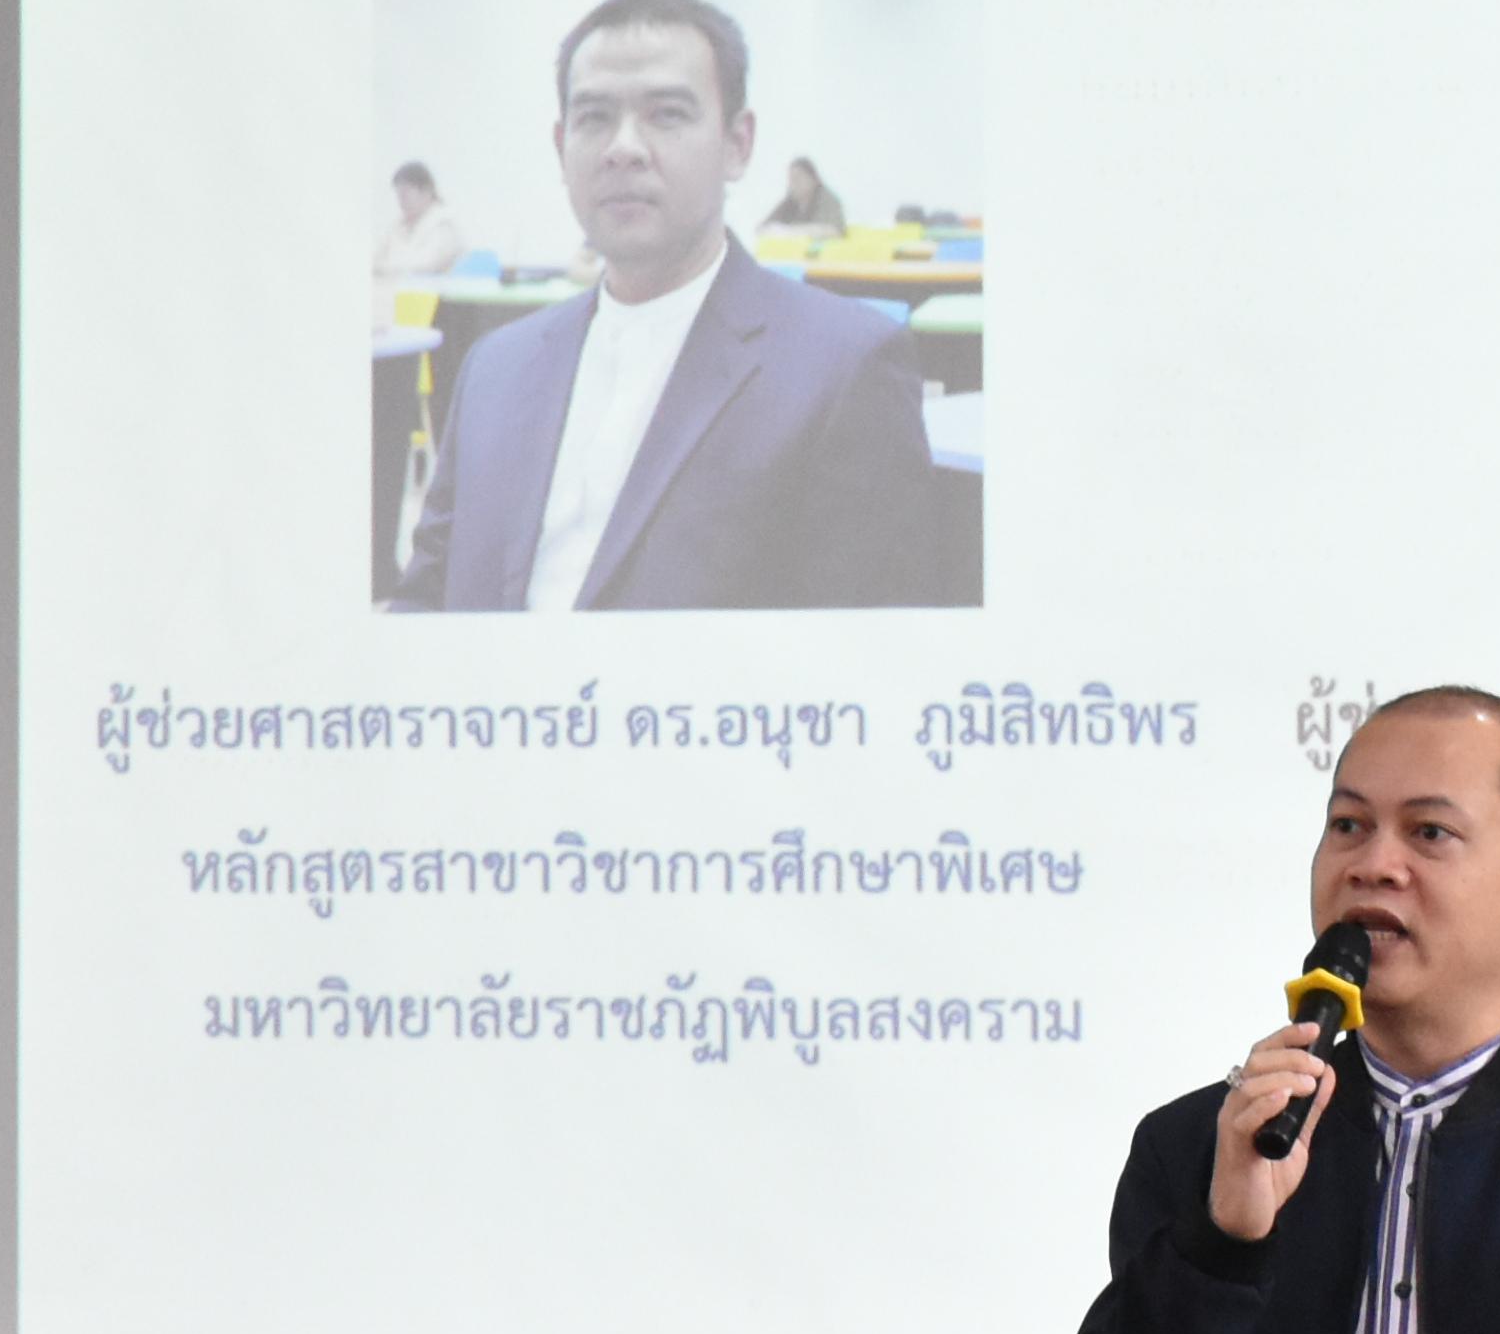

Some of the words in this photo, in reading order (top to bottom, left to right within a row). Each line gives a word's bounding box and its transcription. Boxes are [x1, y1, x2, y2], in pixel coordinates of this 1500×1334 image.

[96, 678, 600, 775] ผู้ช่วยศาสตราจารย์
[624, 698, 867, 772] ดร.อนุชา
[914, 681, 1199, 773] ภูมิสิทธิพร
[181, 825, 1085, 921] หลักสูตรสาขาวิชาการศึกษาพิเศษ
[203, 971, 1082, 1067] มหาวิทยาลัยราชภัฏพิบูลสงคราม
